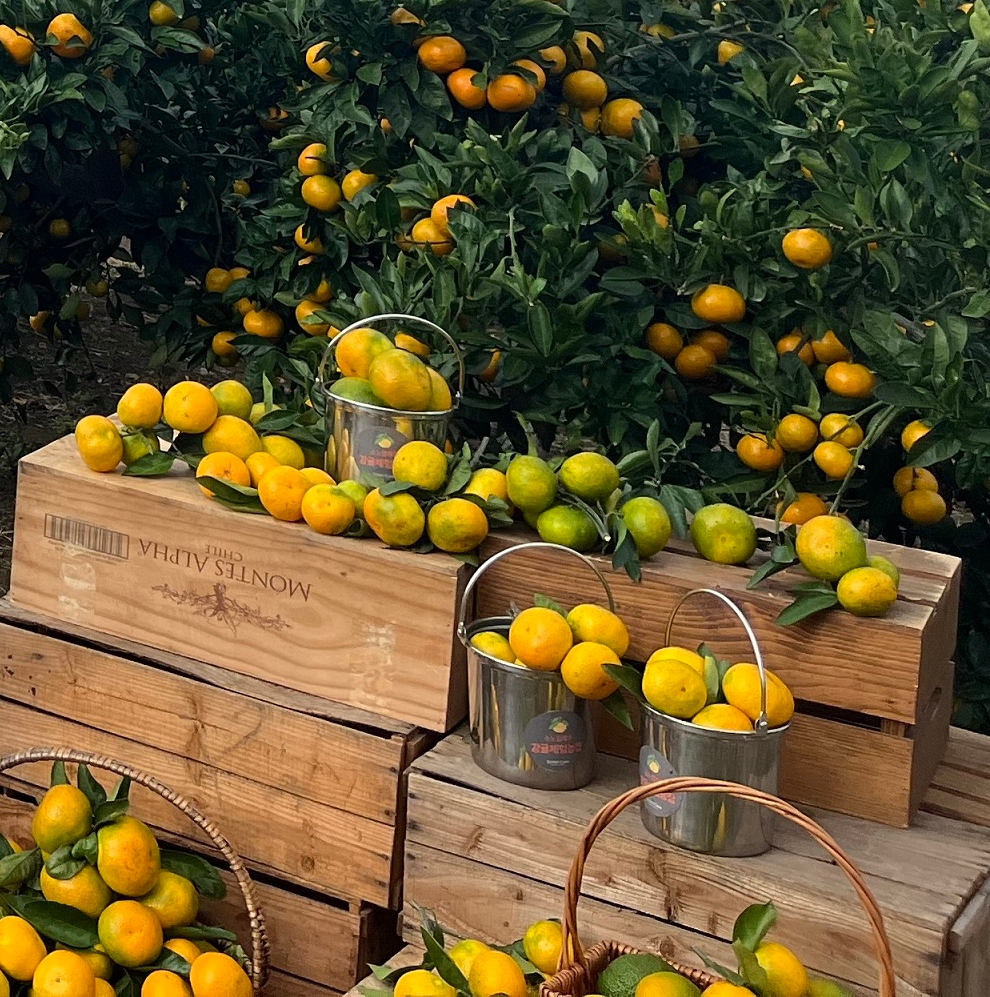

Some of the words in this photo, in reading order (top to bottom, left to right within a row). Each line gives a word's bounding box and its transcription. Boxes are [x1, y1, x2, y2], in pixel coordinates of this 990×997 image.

[138, 538, 209, 573] ALPHA
[205, 544, 243, 562] CHILE
[214, 558, 311, 602] MONTES
